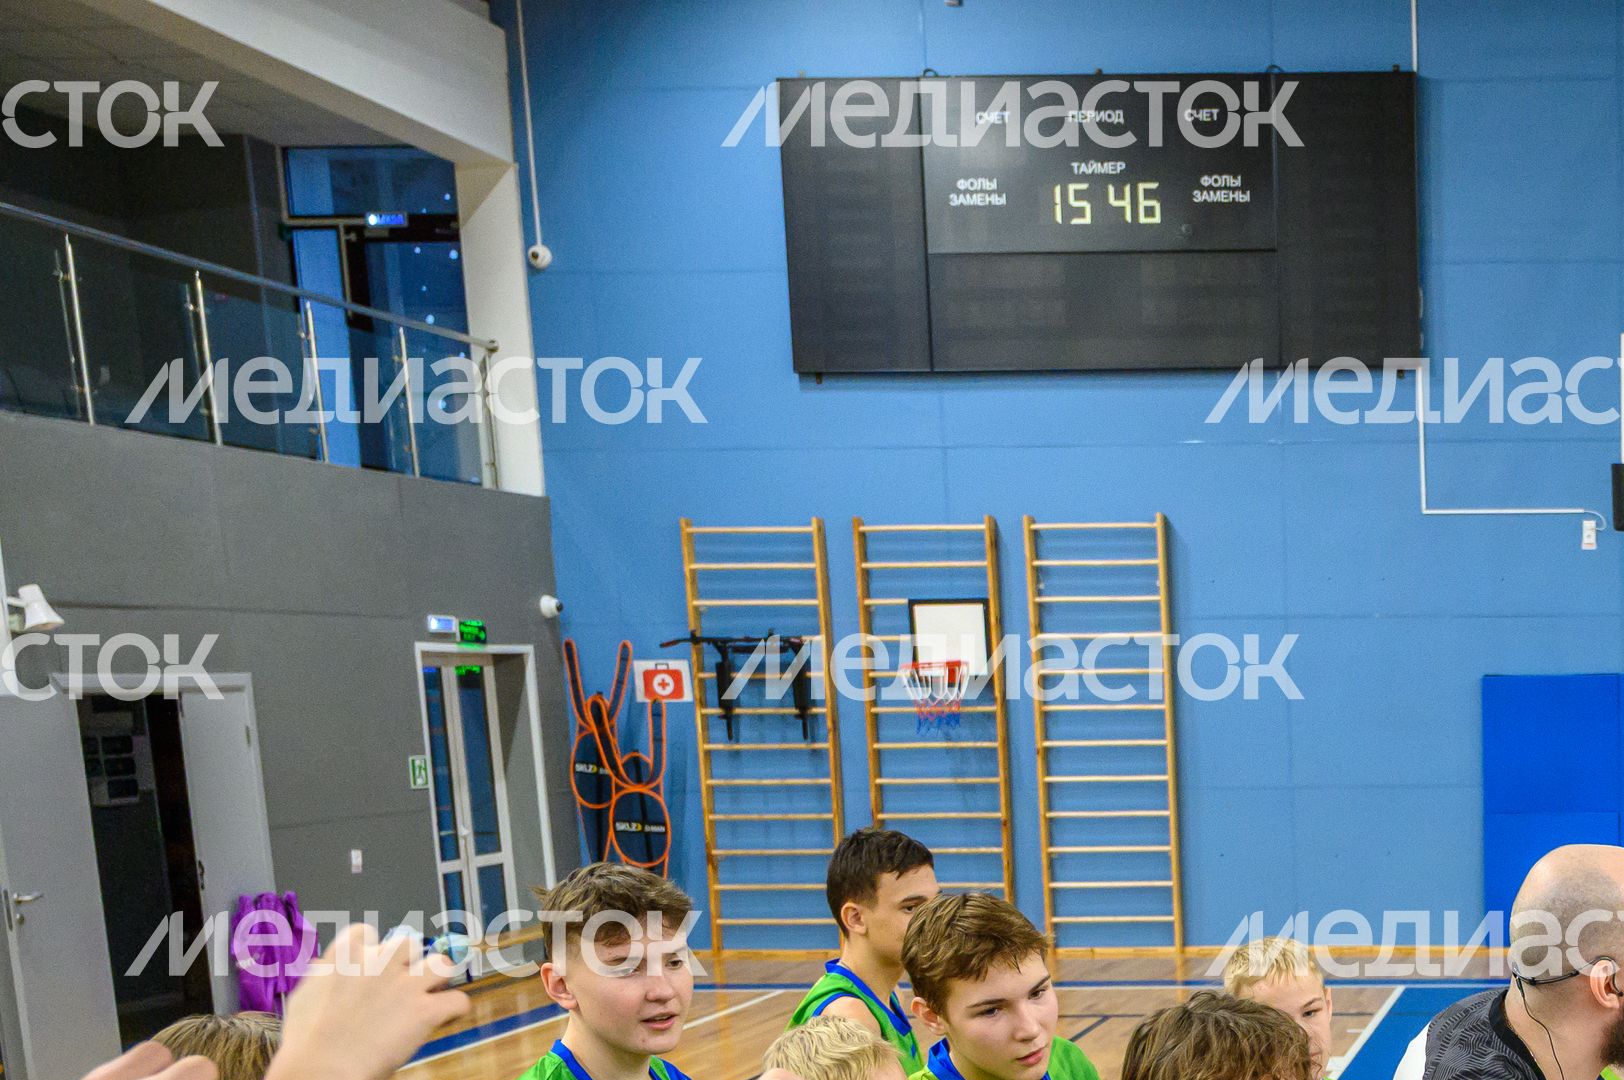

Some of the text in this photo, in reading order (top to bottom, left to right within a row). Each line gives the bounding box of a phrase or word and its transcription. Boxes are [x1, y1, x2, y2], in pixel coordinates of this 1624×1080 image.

[976, 111, 1010, 124] СЧЕТ
[1068, 110, 1124, 124] ПЕРИОД
[1184, 109, 1219, 122] СЧЕТ
[1071, 161, 1126, 175] ТАЙМЕР
[956, 178, 998, 191] ФОЛЫ
[1200, 175, 1241, 188] ФОЛЫ
[949, 193, 1007, 206] ЗАМЕНЫ
[1193, 190, 1250, 203] ЗАМЕНЫ
[1054, 182, 1161, 225] 15 46
